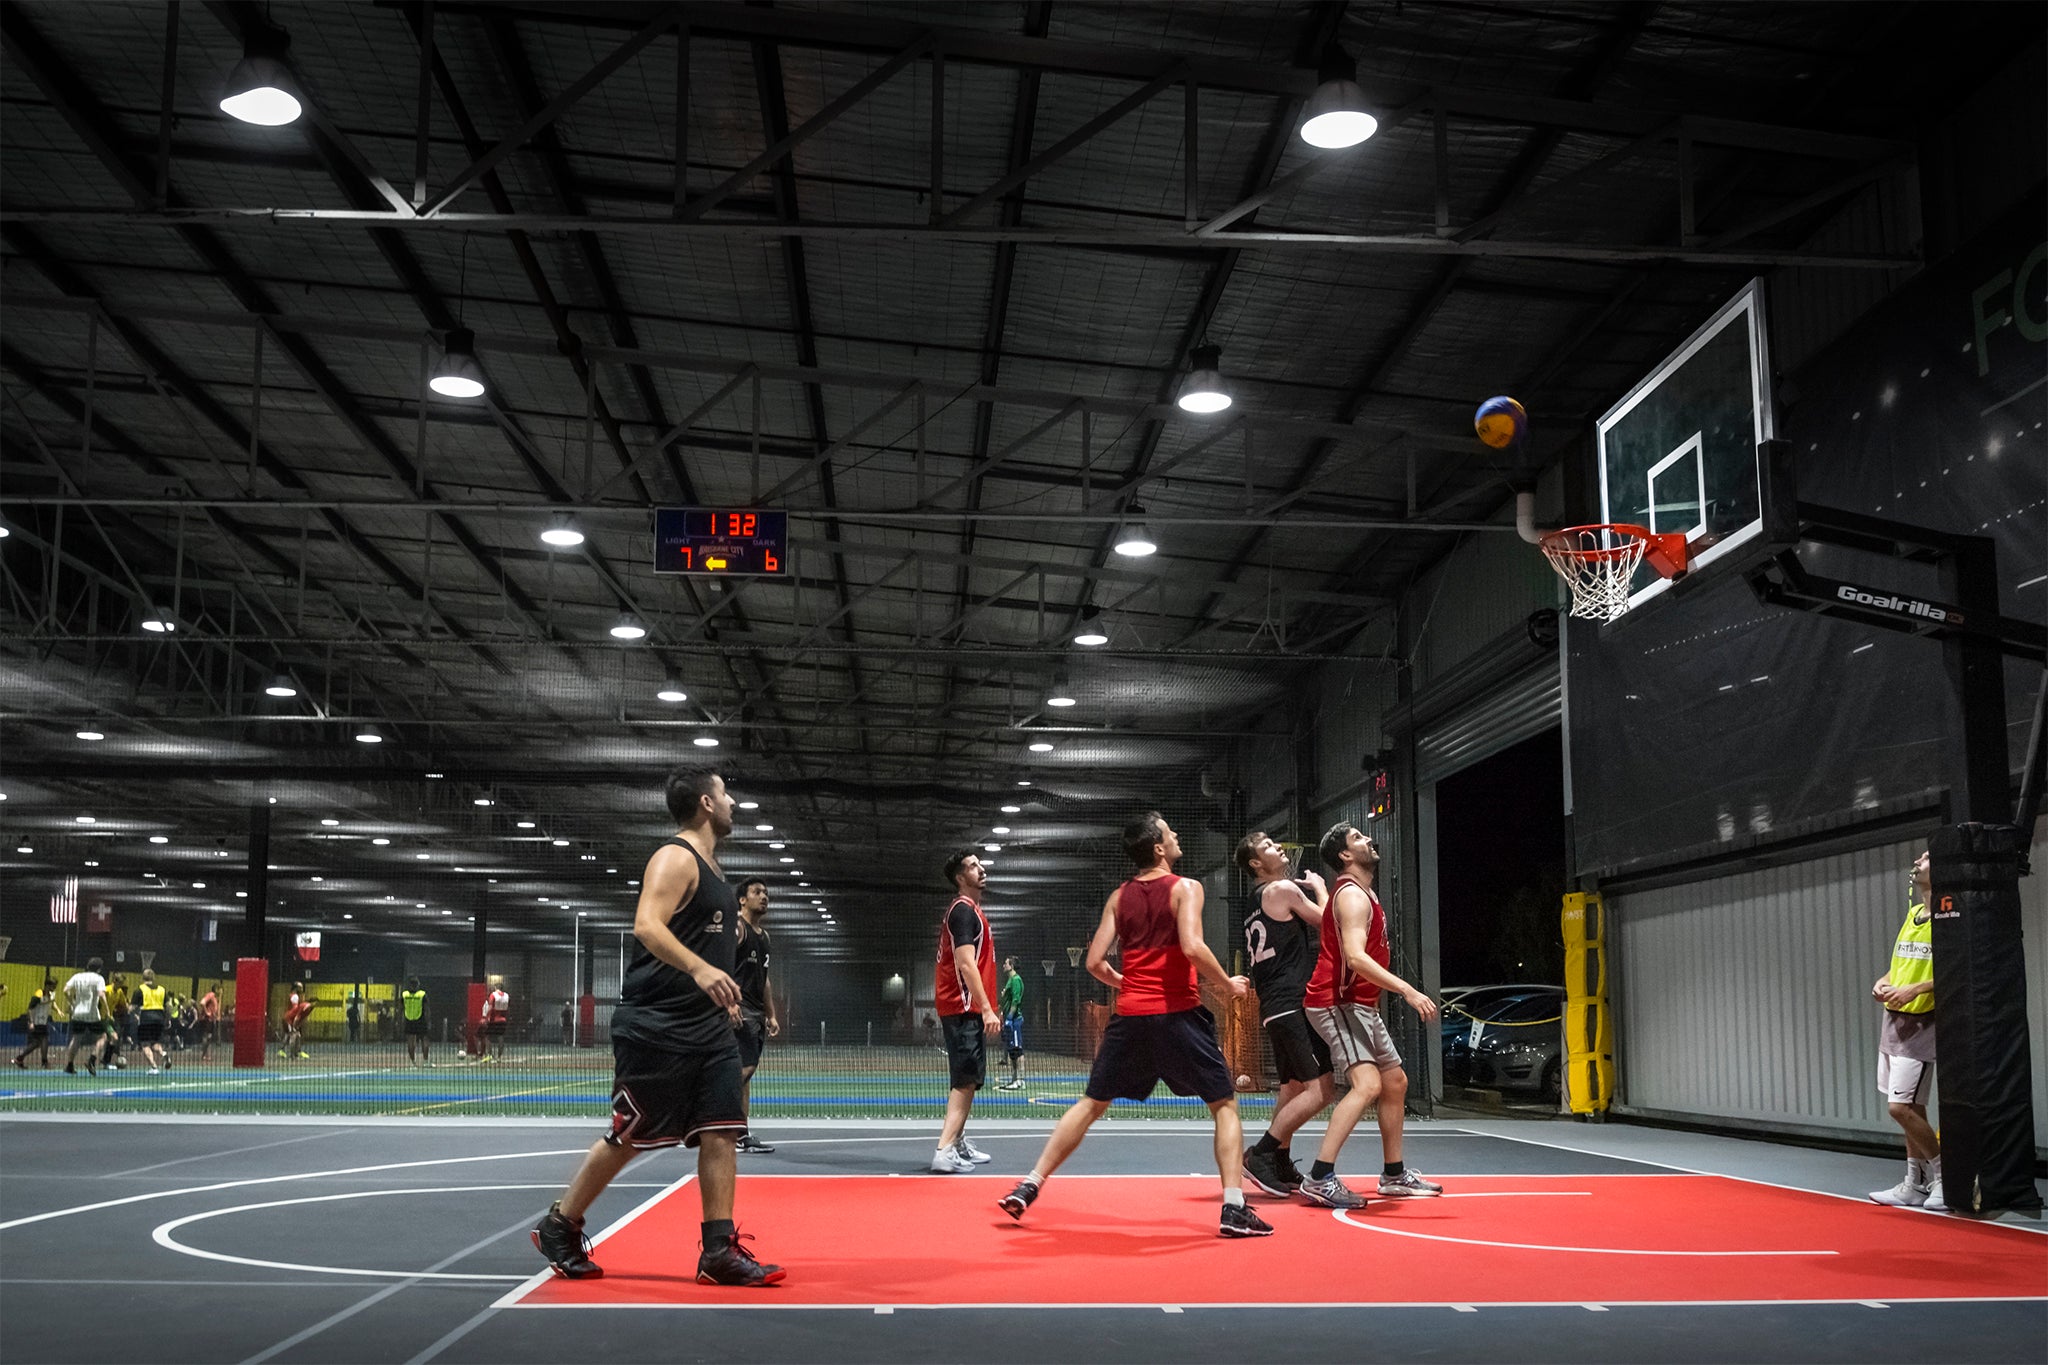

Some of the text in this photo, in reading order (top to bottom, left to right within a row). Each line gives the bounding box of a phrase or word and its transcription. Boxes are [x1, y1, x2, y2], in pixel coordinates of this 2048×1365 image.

[665, 537, 690, 545] LIGHT
[680, 547, 692, 569] 7
[730, 546, 744, 556] CITY
[1837, 586, 1946, 621] Goalrilla
